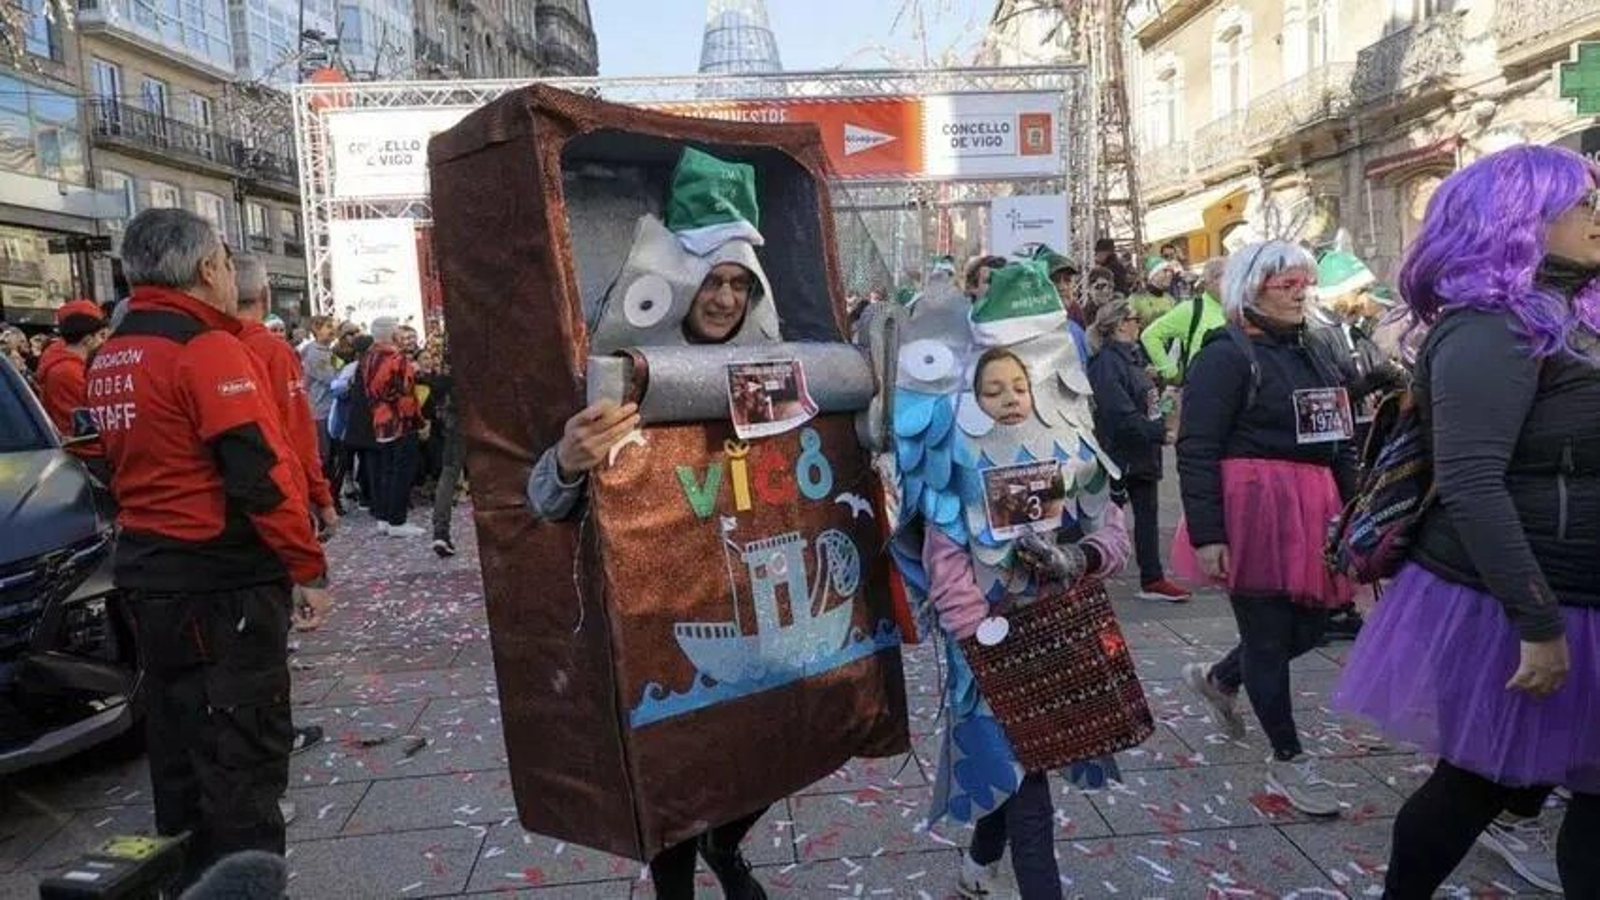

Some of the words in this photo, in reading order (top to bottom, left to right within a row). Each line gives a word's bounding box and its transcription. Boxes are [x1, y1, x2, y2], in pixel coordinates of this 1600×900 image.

[942, 121, 1010, 135] CONCELLO
[951, 138, 968, 148] DE
[972, 136, 1003, 147] VIGO
[380, 154, 413, 166] VIGO
[90, 403, 136, 432] STAFF
[1027, 495, 1042, 520] 3
